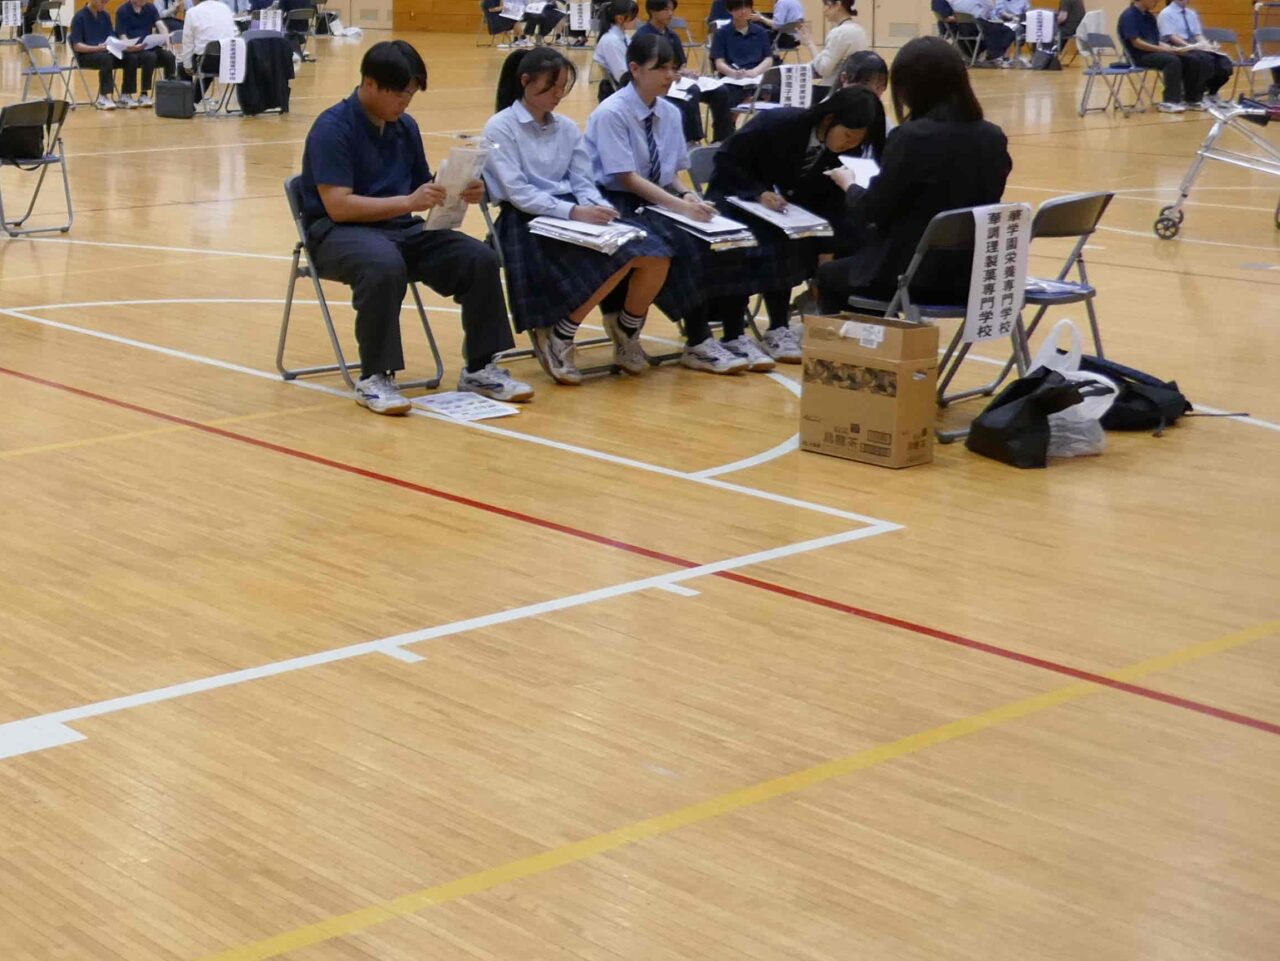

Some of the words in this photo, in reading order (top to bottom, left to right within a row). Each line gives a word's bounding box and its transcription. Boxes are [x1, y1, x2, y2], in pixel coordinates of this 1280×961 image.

[977, 211, 1002, 338] 華調理製菓専門学校
[998, 209, 1023, 334] 華学園栄養専門学校
